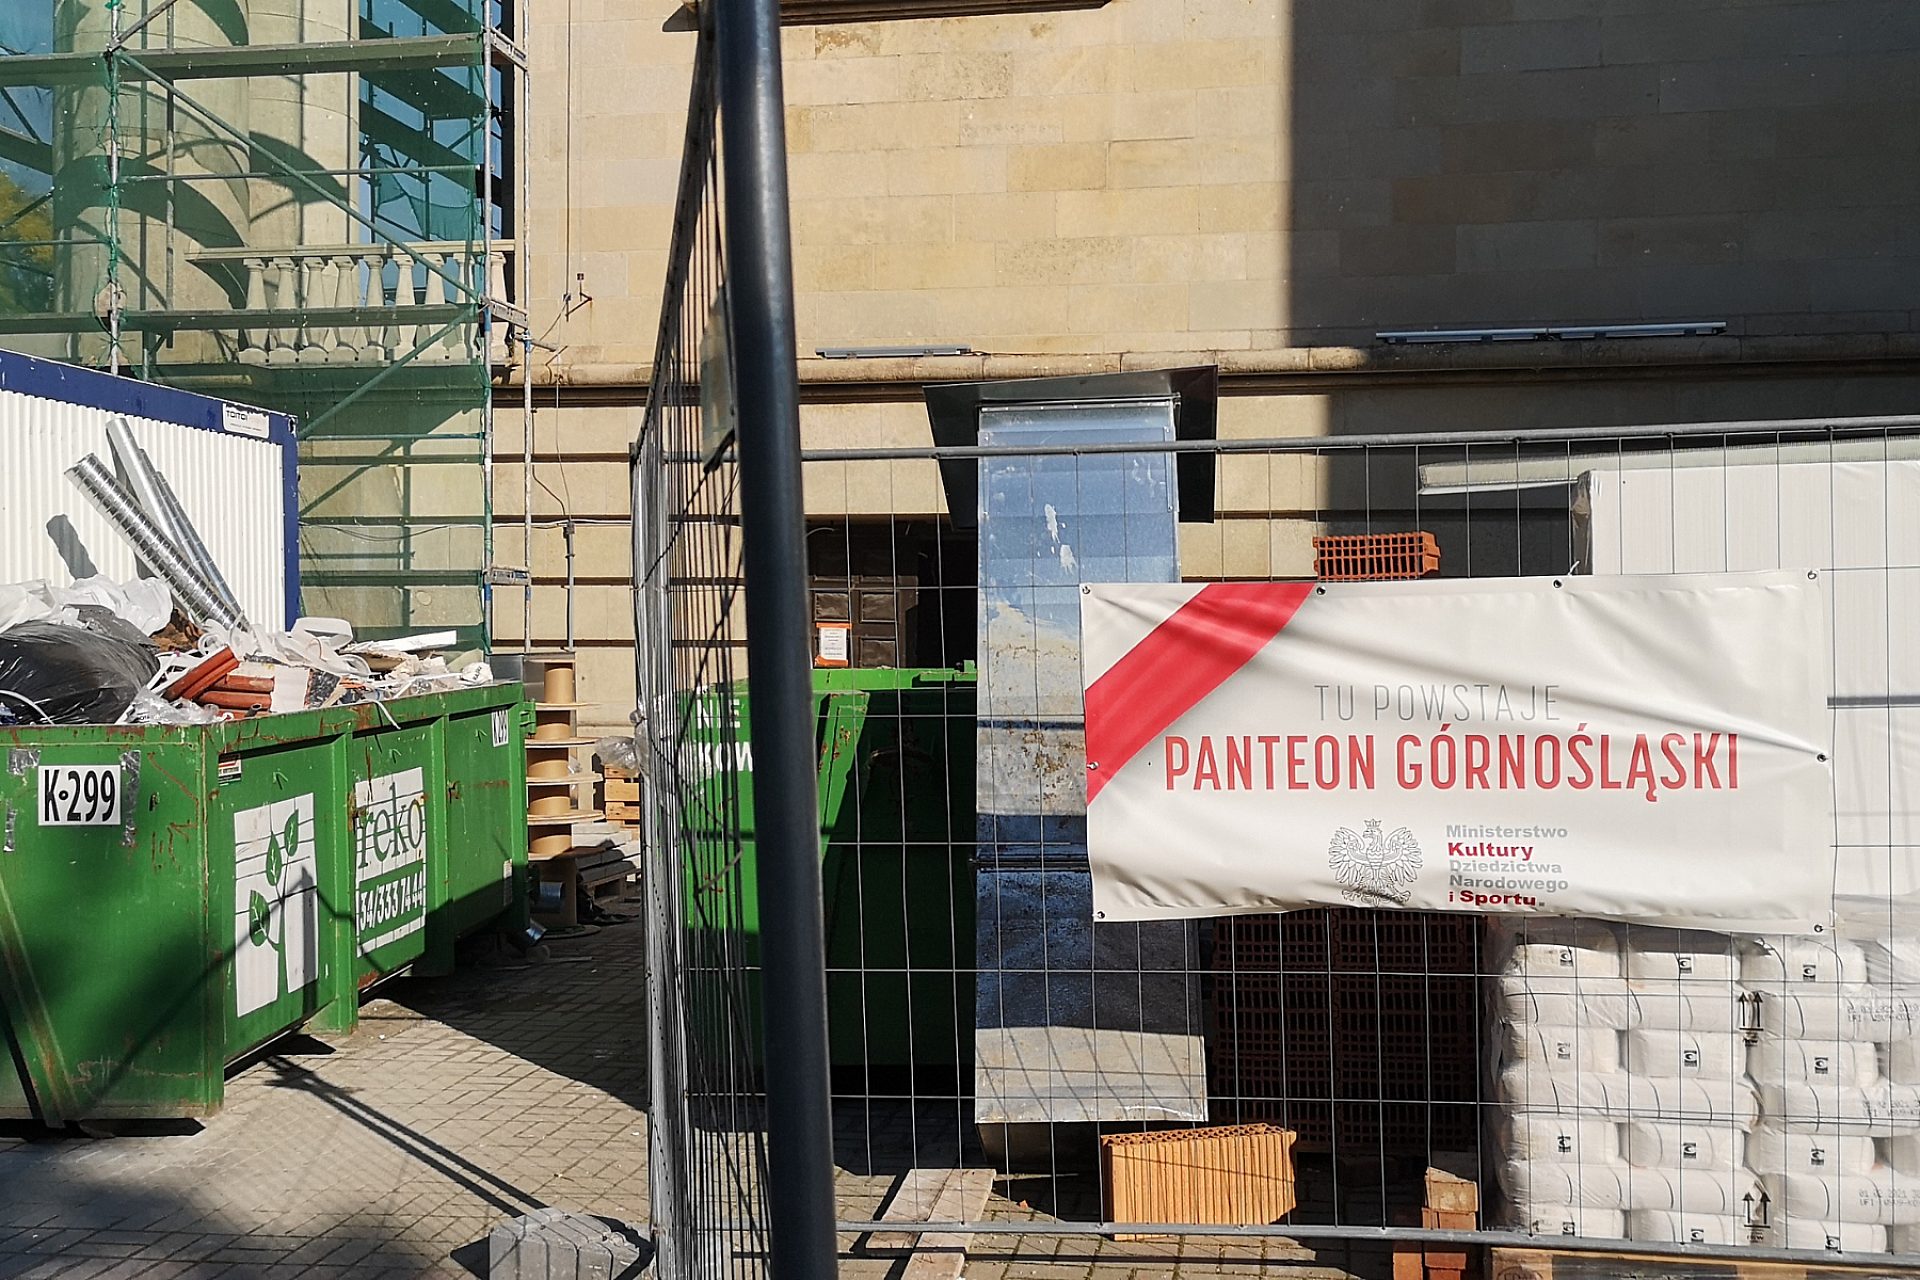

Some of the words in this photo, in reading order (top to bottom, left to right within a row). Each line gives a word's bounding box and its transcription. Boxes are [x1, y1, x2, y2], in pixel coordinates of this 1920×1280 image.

[1314, 685, 1354, 721] TU
[1374, 684, 1561, 722] POWSTAJE
[1165, 735, 1375, 790] PANTEON
[1396, 723, 1738, 802] GÓRNOŚLĄSKI
[357, 782, 423, 869] reko
[1446, 824, 1568, 838] Ministerstwo
[1448, 842, 1533, 861] Kultury
[1449, 859, 1562, 873] Dziedzictwa
[1449, 874, 1568, 893] Narodowego
[1449, 891, 1454, 902] i
